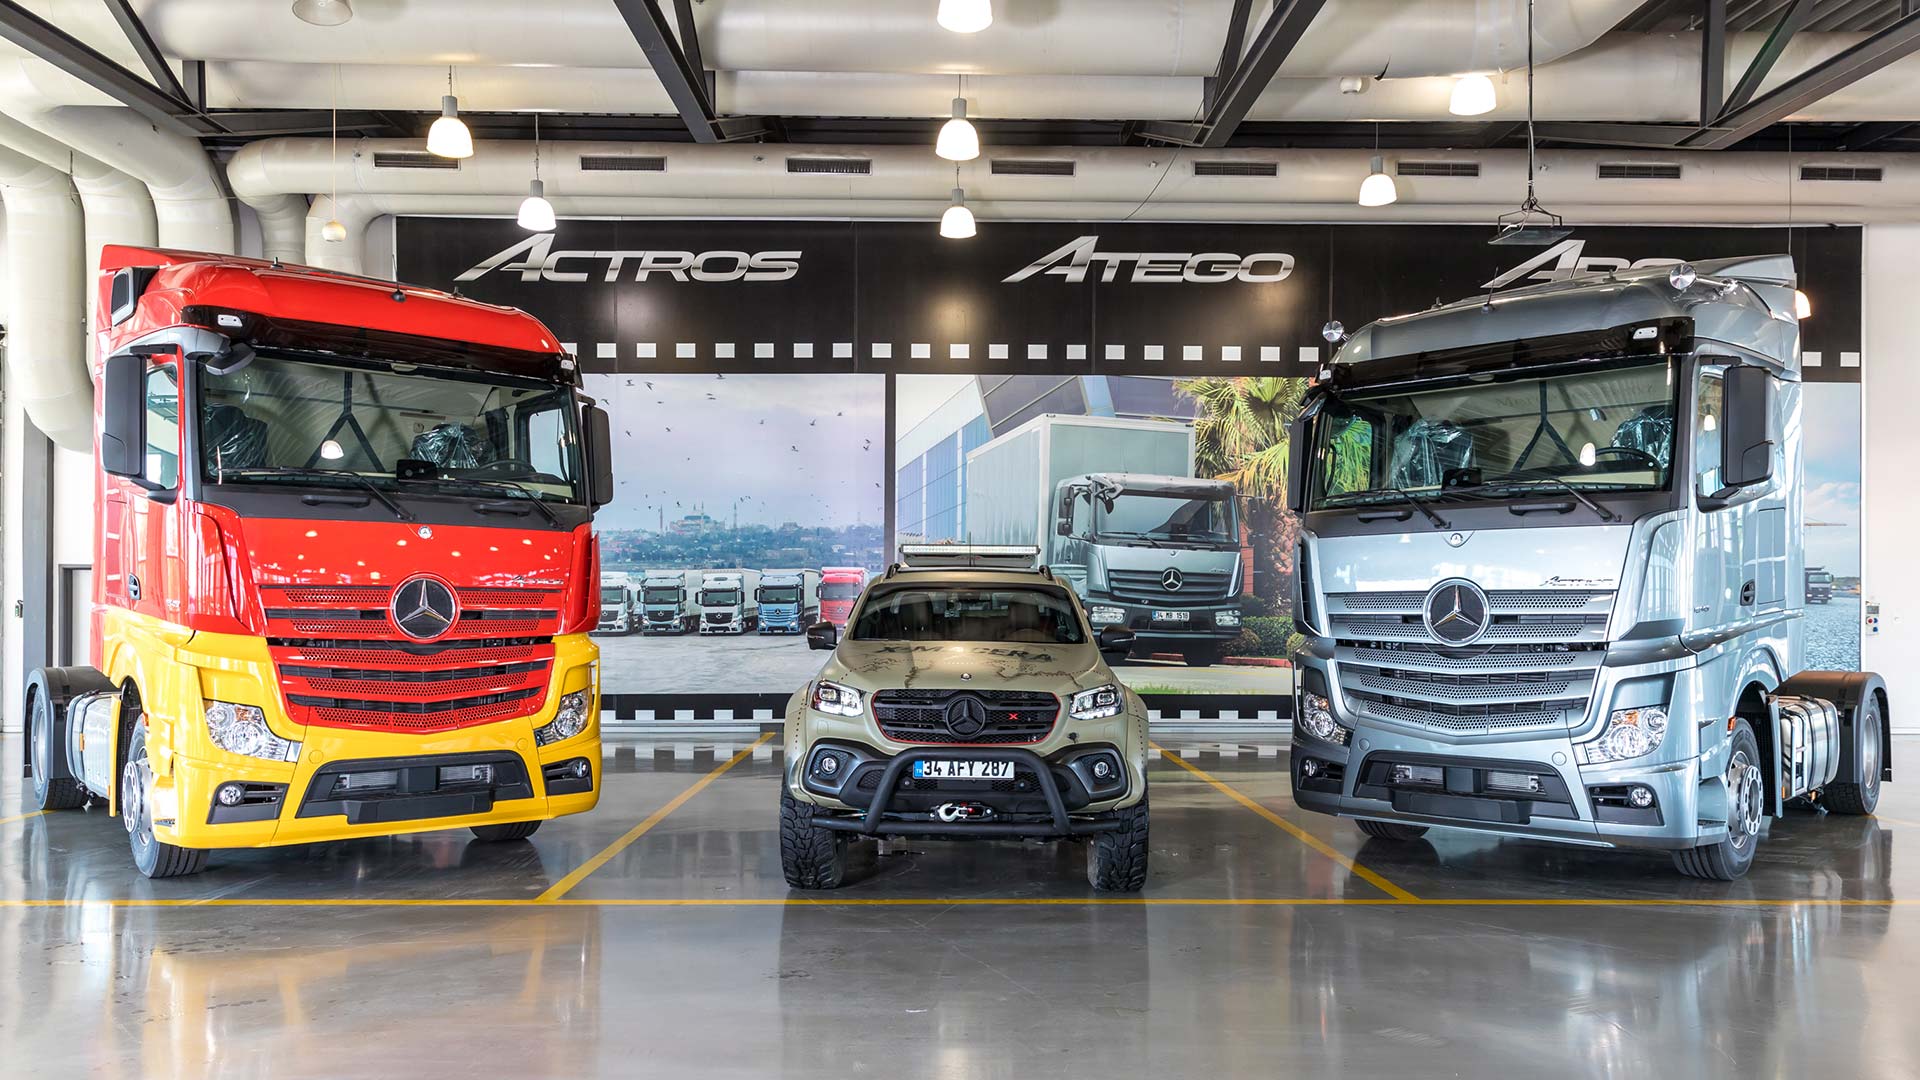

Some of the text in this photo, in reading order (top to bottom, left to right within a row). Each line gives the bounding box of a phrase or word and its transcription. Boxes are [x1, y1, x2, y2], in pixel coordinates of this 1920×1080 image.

[453, 232, 803, 283] ACTROS
[1000, 235, 1295, 283] ATEGO
[874, 646, 1056, 663] X-MCERA
[923, 761, 942, 776] 34
[947, 761, 975, 776] AFY
[981, 761, 1009, 776] 287
